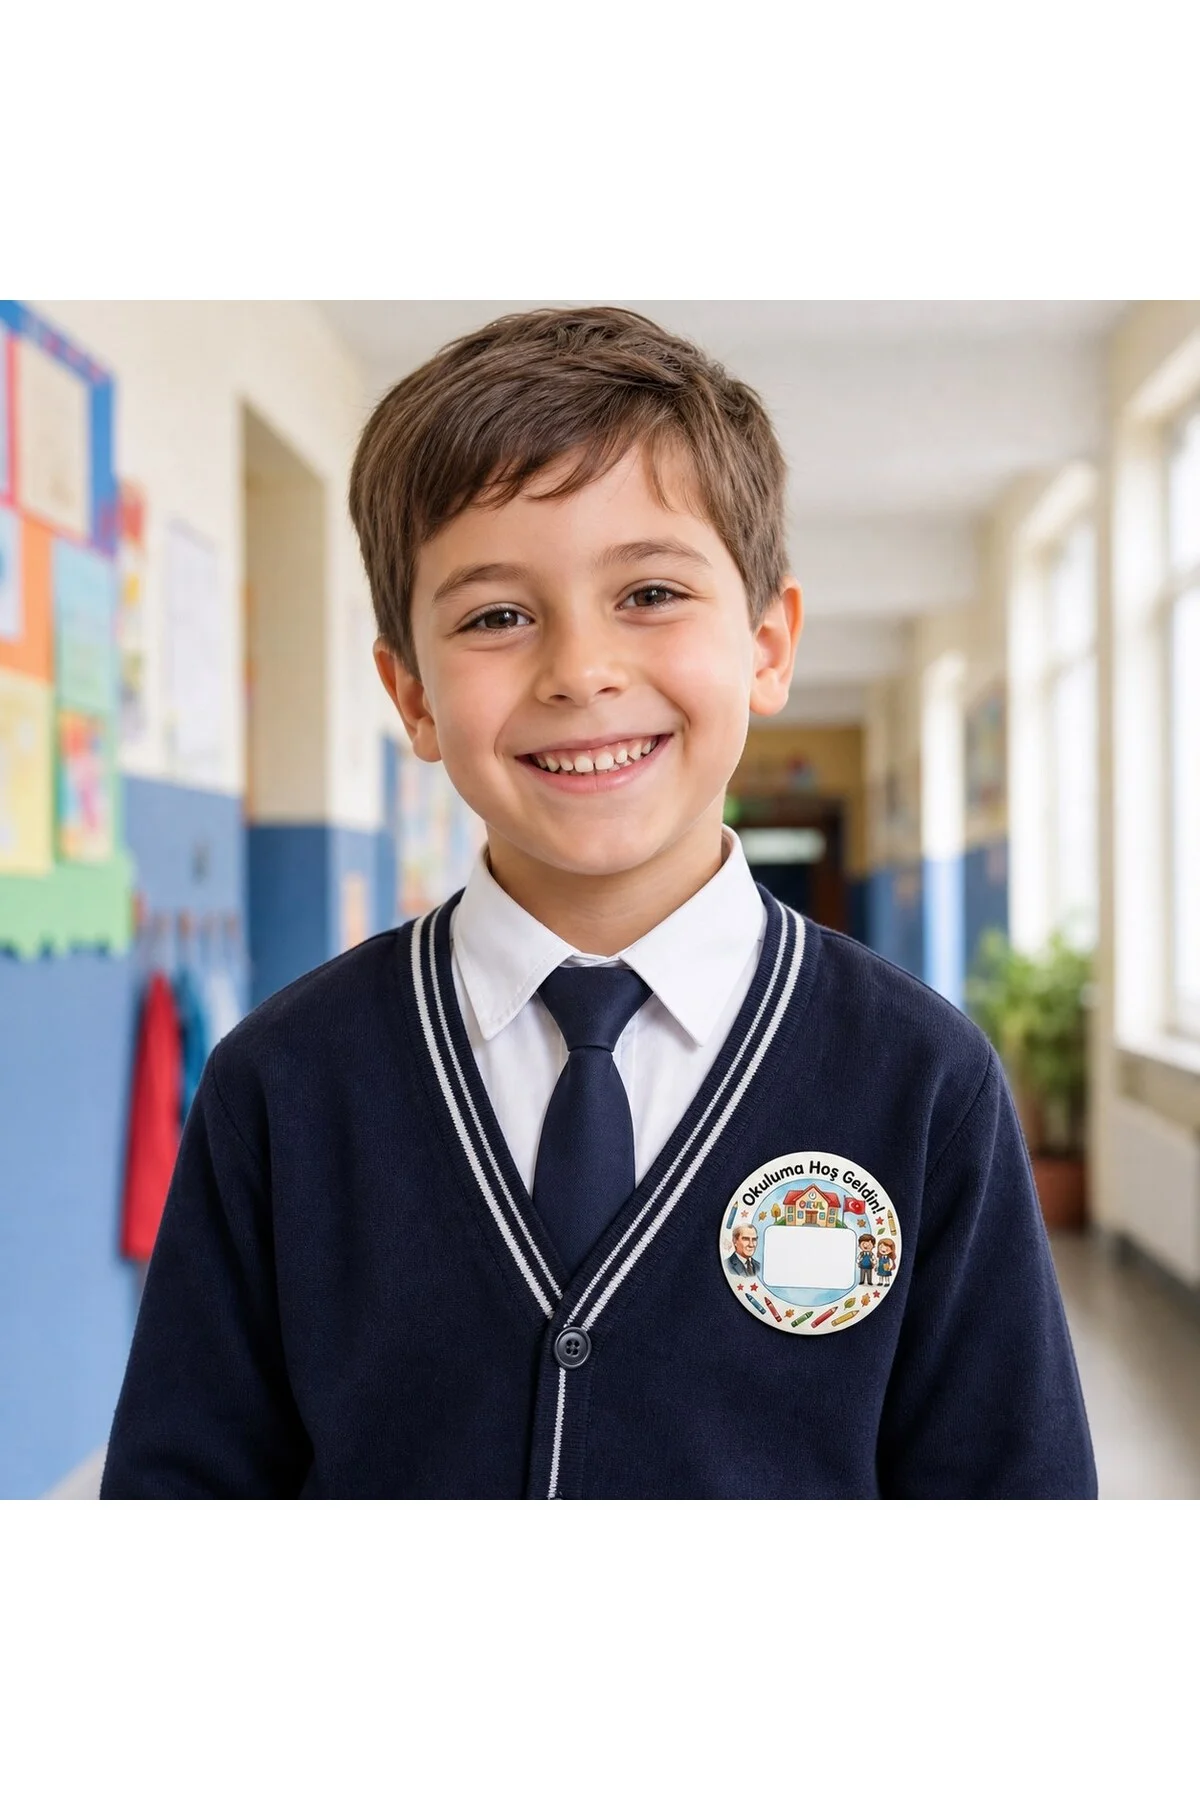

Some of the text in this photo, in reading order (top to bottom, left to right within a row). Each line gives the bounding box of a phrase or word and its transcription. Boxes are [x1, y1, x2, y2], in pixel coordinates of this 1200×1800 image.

[742, 1161, 885, 1214] Okuluma Hoş Geldin!
[799, 1200, 825, 1210] OKUL
